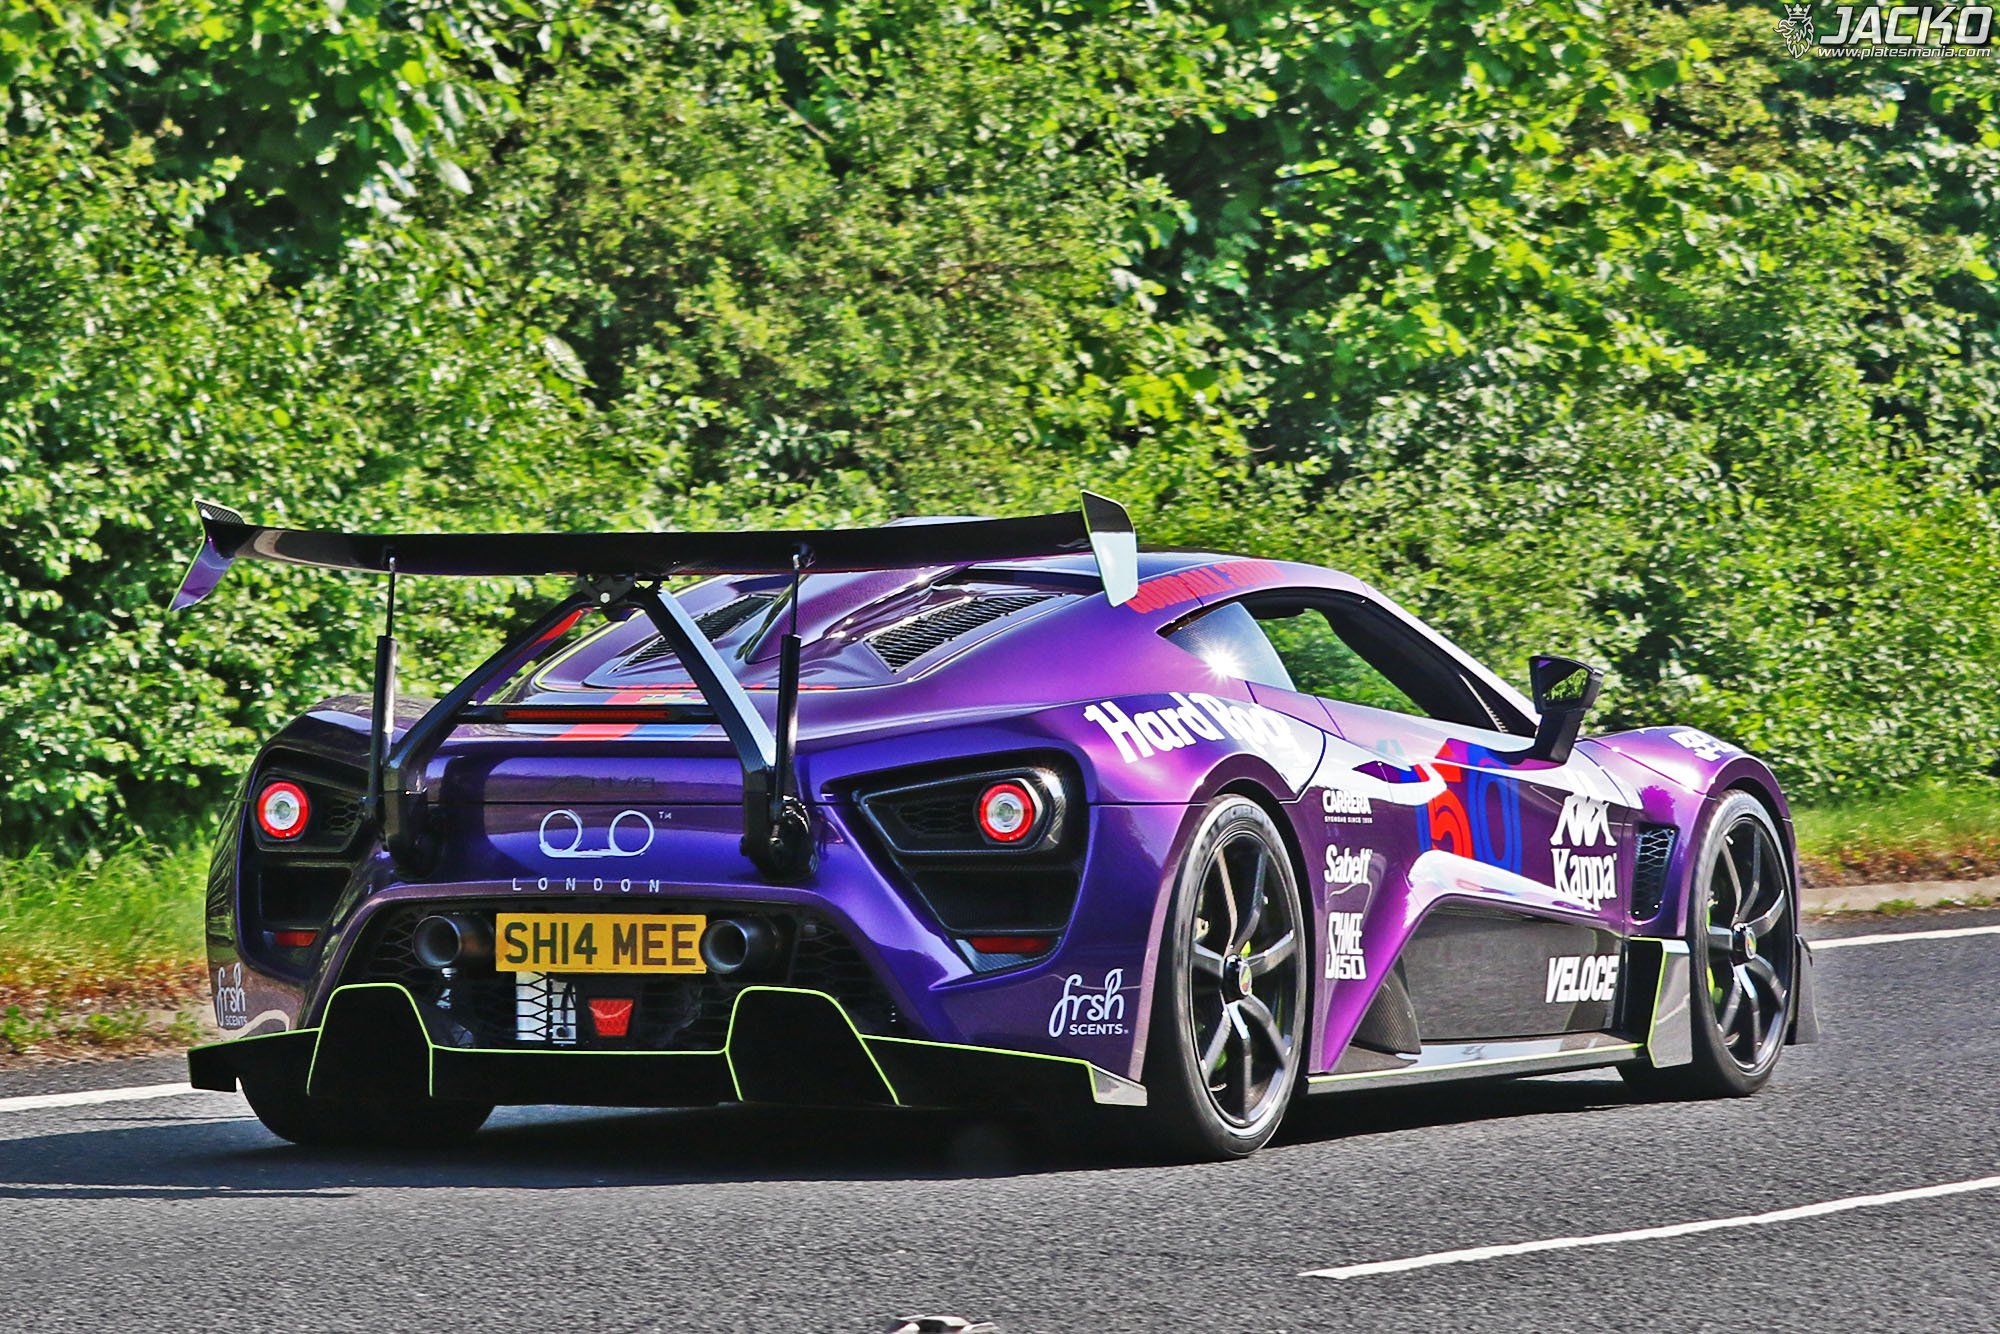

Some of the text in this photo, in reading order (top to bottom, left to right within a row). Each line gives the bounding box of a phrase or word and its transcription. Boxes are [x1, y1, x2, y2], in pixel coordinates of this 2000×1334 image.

[1083, 692, 1225, 764] Hard
[512, 877, 660, 893] LONDON
[1324, 844, 1373, 884] Sabelt
[1551, 848, 1617, 911] Kappa
[504, 921, 697, 966] SH14 MEE
[217, 962, 246, 1027] frsh
[1049, 968, 1125, 1038] frsh
[1545, 956, 1620, 1003] VELOCE
[1069, 1023, 1124, 1036] SCENTS
